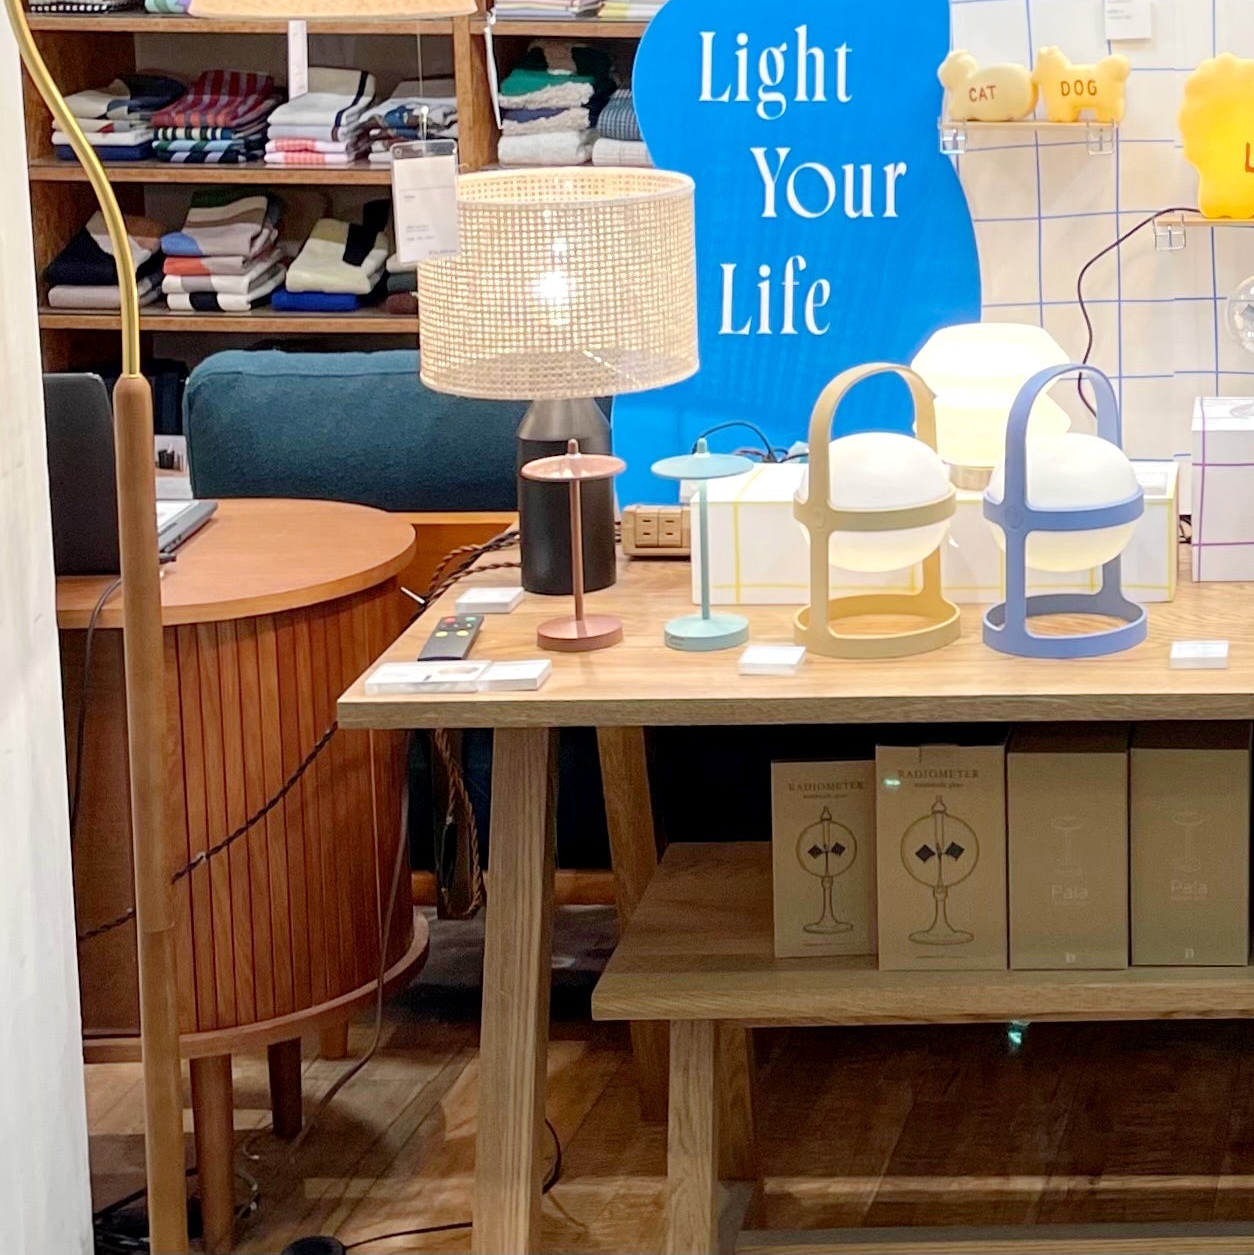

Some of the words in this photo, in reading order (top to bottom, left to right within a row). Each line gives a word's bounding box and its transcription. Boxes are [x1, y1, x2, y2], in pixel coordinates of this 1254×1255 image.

[698, 24, 853, 121] Light
[968, 85, 997, 103] CAT
[1060, 79, 1098, 97] DOG
[749, 147, 907, 219] Your
[718, 254, 832, 336] Life
[896, 768, 980, 779] RADIOMETER
[788, 780, 865, 792] RADIOMETER
